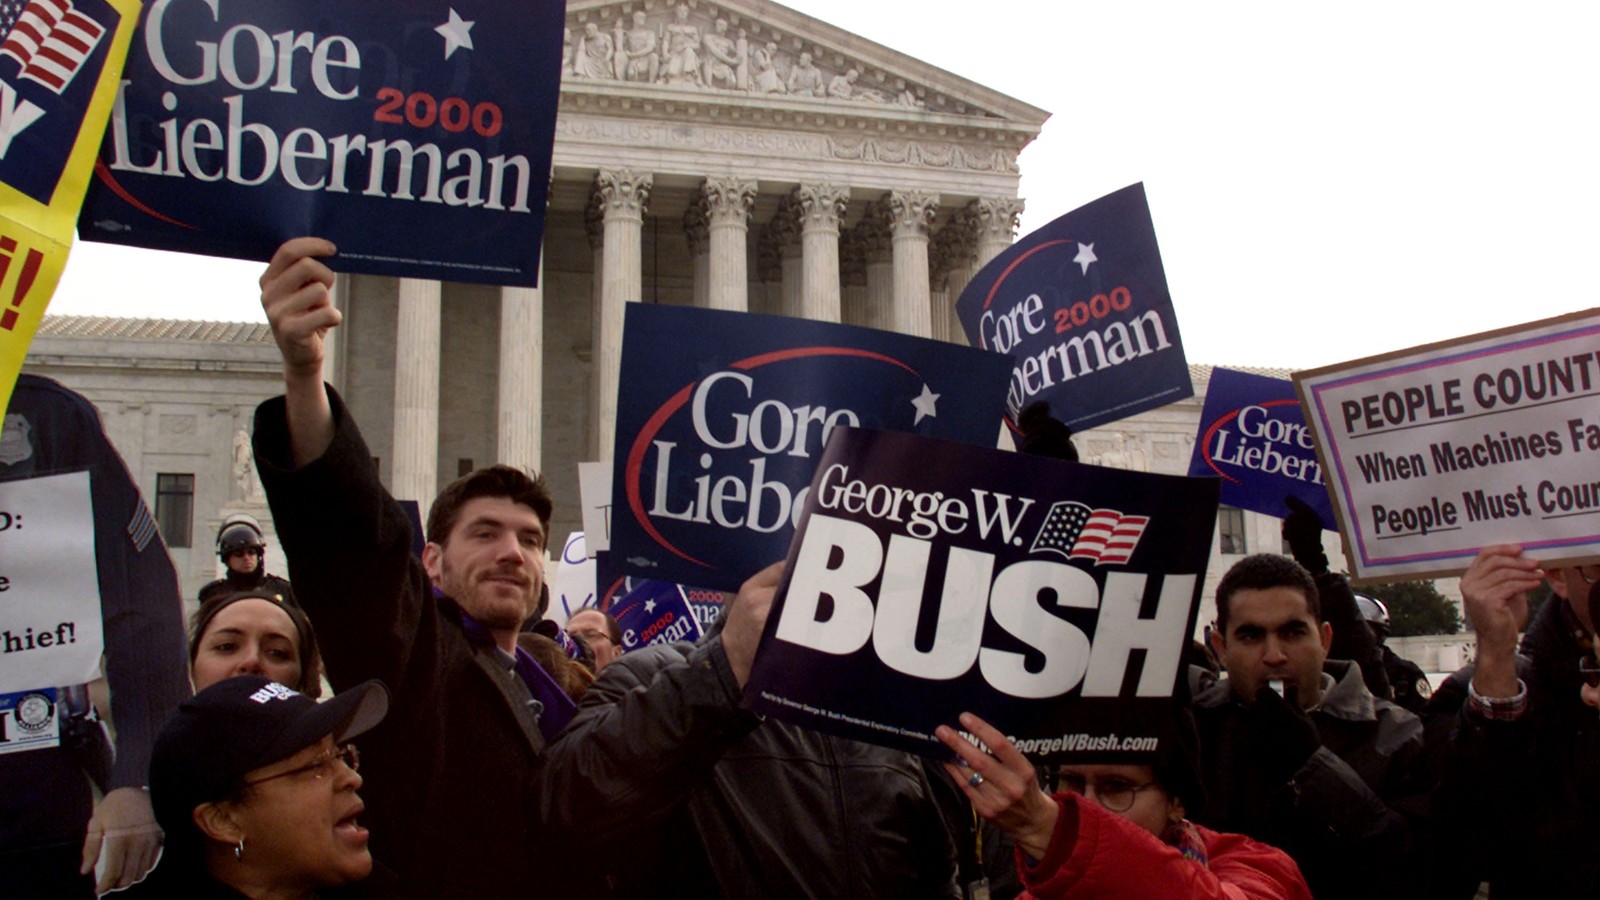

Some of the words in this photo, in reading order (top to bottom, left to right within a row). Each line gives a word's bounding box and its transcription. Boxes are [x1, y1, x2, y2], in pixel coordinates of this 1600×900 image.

[145, 0, 361, 100] Gore
[374, 87, 503, 138] 2000
[557, 119, 608, 138] QUAL
[702, 128, 772, 149] UNDER
[109, 79, 532, 214] Lieberman
[980, 293, 1046, 355] Gore
[1054, 285, 1132, 334] 2000
[1237, 405, 1316, 449] Gore
[1341, 378, 1465, 434] PEOPLE
[1356, 451, 1427, 483] When
[1429, 430, 1563, 474] Machines
[1567, 415, 1600, 453] Fa
[818, 463, 969, 540] George
[971, 488, 1036, 547] W.
[1371, 496, 1458, 536] People
[1462, 485, 1532, 522] Must
[775, 513, 1197, 699] BUSH
[0, 622, 76, 654] hief!
